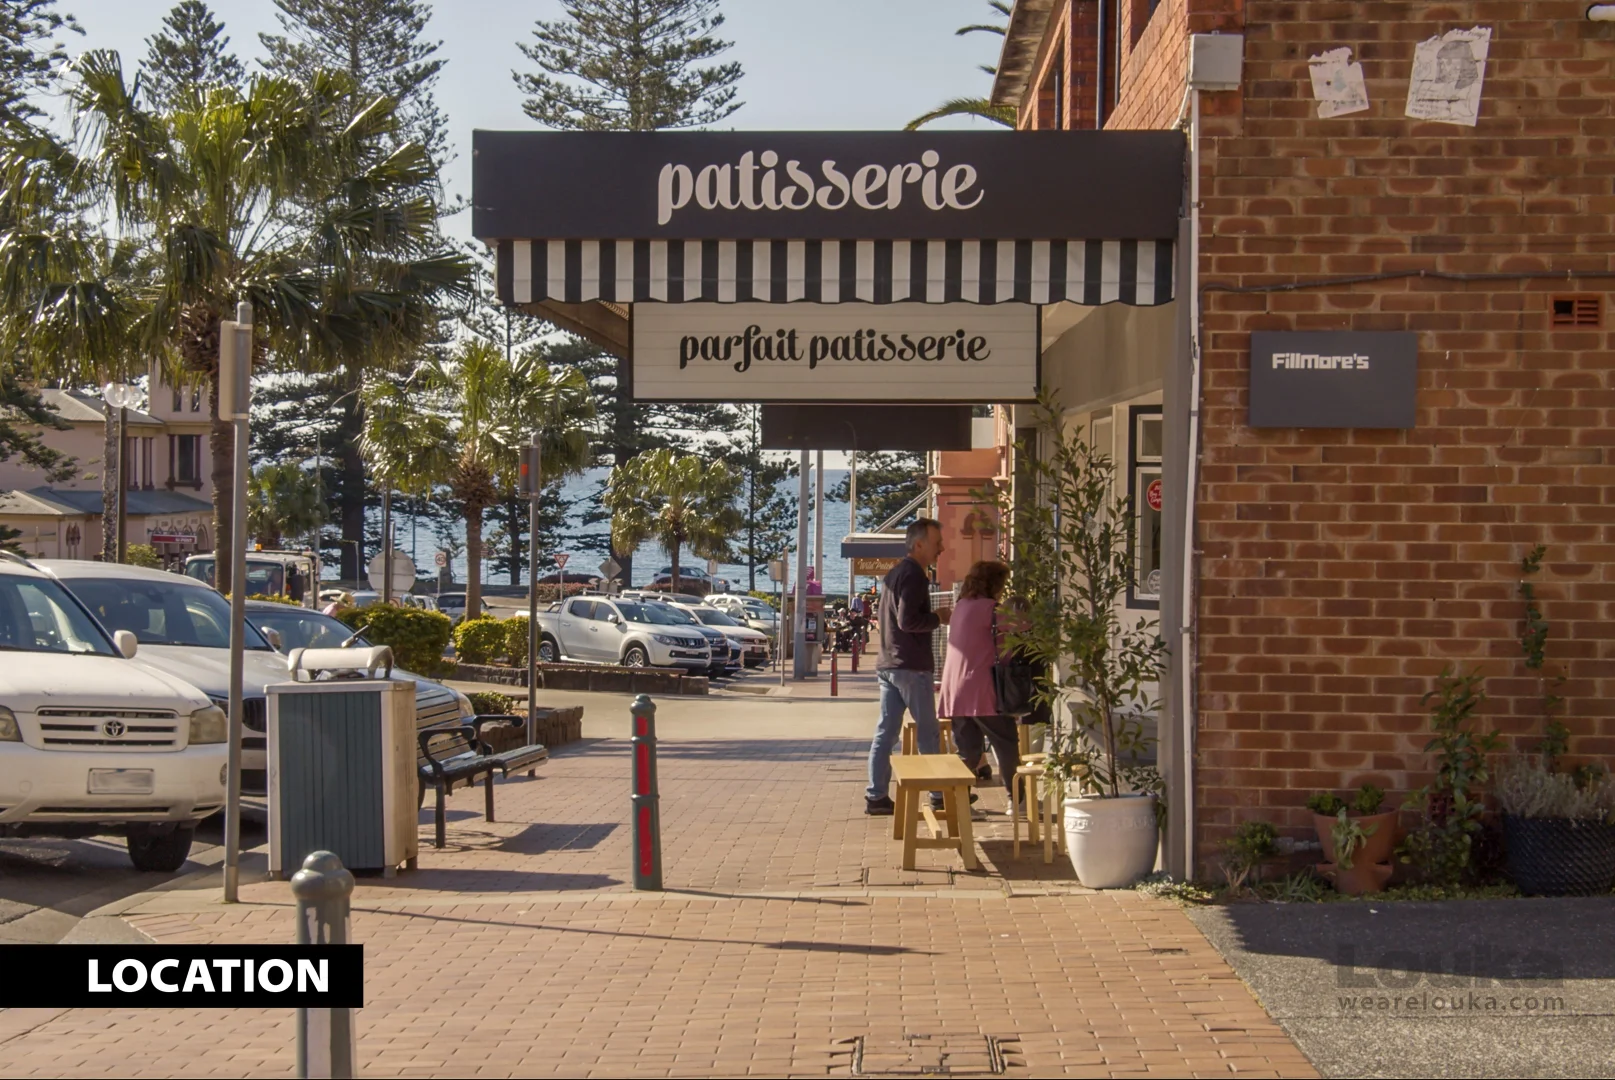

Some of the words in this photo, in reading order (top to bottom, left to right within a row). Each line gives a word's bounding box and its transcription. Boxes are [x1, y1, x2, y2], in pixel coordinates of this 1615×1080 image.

[657, 150, 985, 226] patisserie
[679, 325, 804, 373] parfait
[809, 329, 991, 370] patisserie
